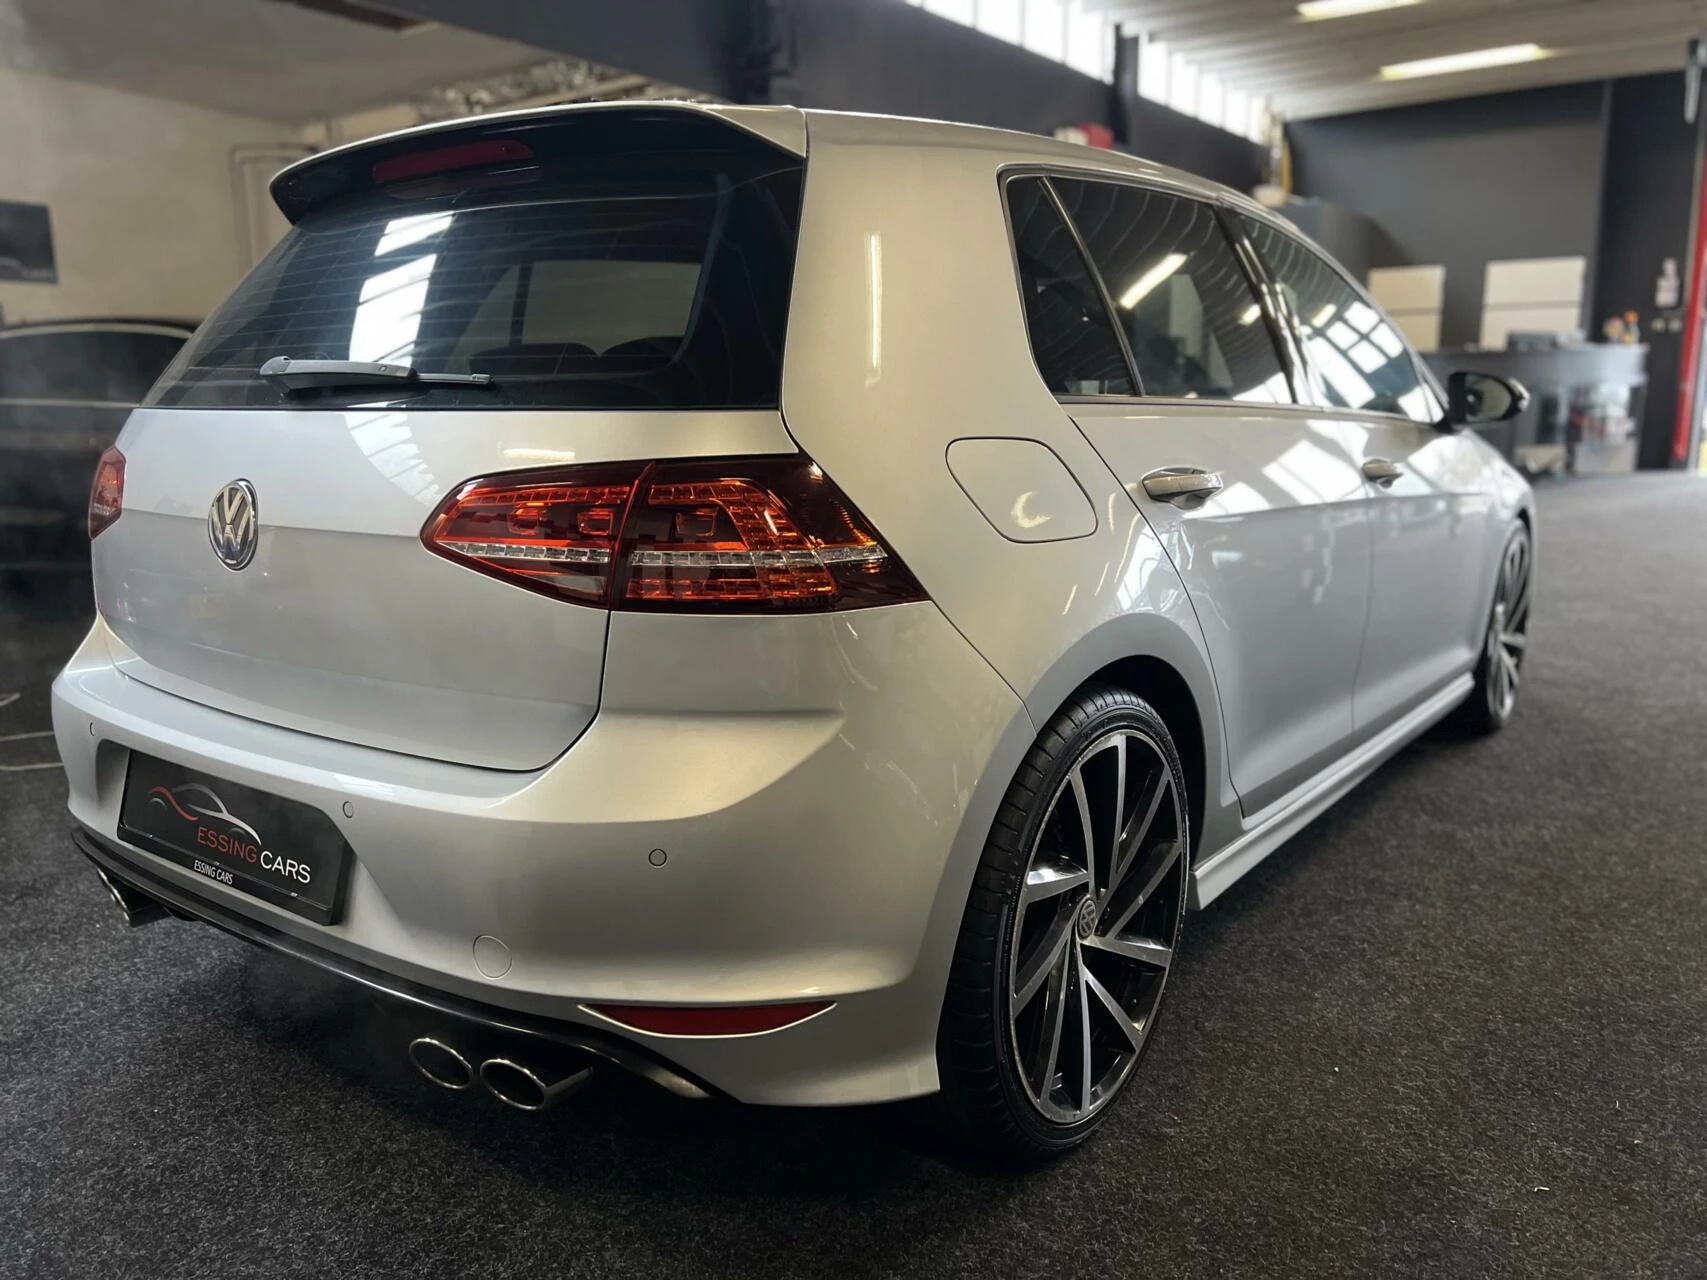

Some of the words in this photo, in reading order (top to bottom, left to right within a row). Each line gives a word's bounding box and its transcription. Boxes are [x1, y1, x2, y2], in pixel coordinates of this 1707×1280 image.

[209, 480, 257, 570] VW
[194, 860, 216, 878] ESSING
[216, 869, 234, 885] CARS
[197, 826, 257, 863] ESSING
[260, 850, 311, 884] CARS
